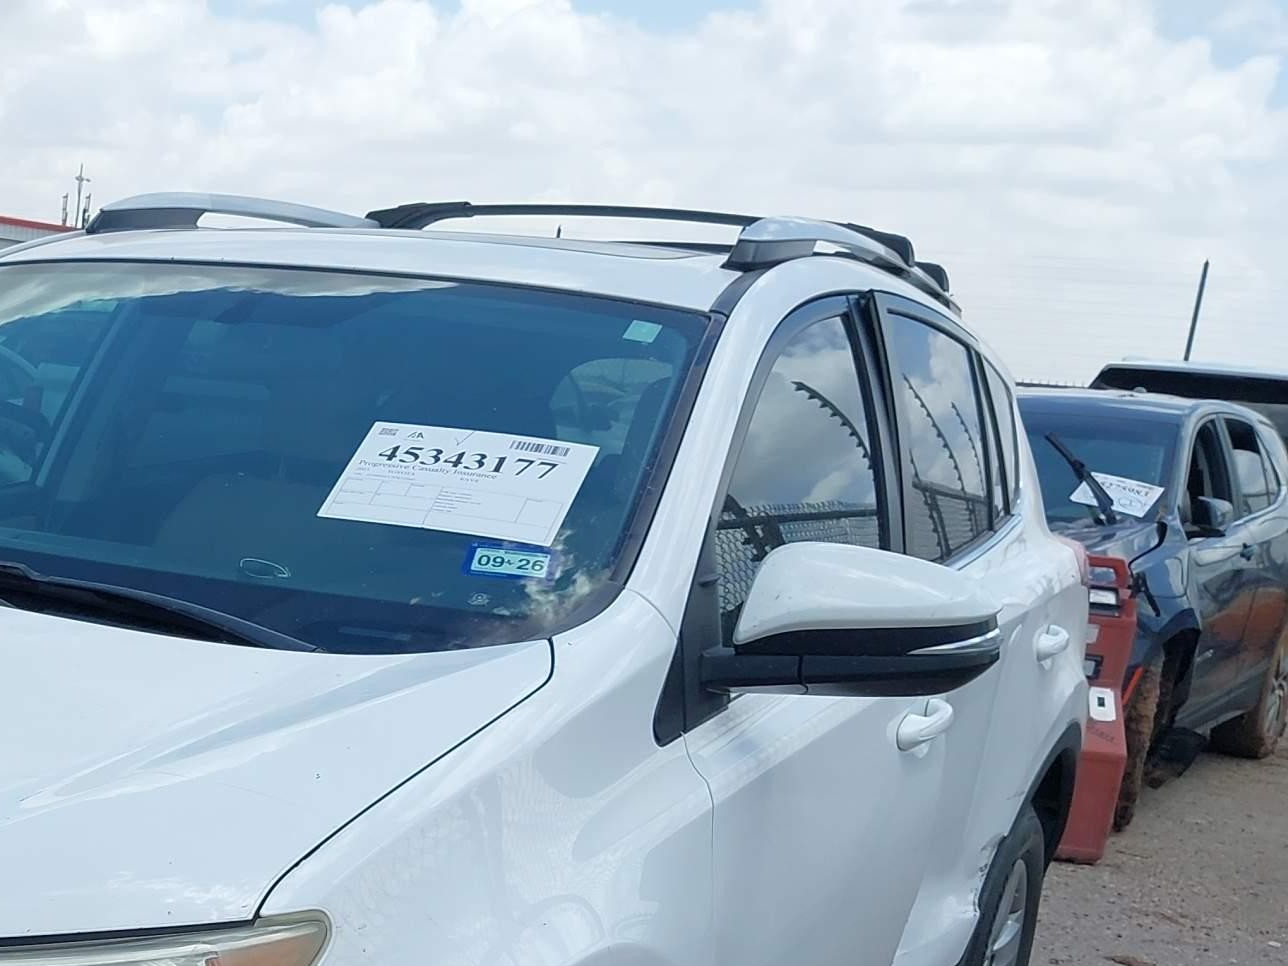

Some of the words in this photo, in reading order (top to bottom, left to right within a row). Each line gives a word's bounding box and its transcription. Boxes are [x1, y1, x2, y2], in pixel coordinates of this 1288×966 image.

[358, 459, 411, 471] Progressive
[412, 464, 450, 475] Casualty
[452, 468, 498, 480] Insurance
[378, 444, 560, 480] 45343177
[477, 554, 505, 568] 09
[516, 558, 545, 572] 26
